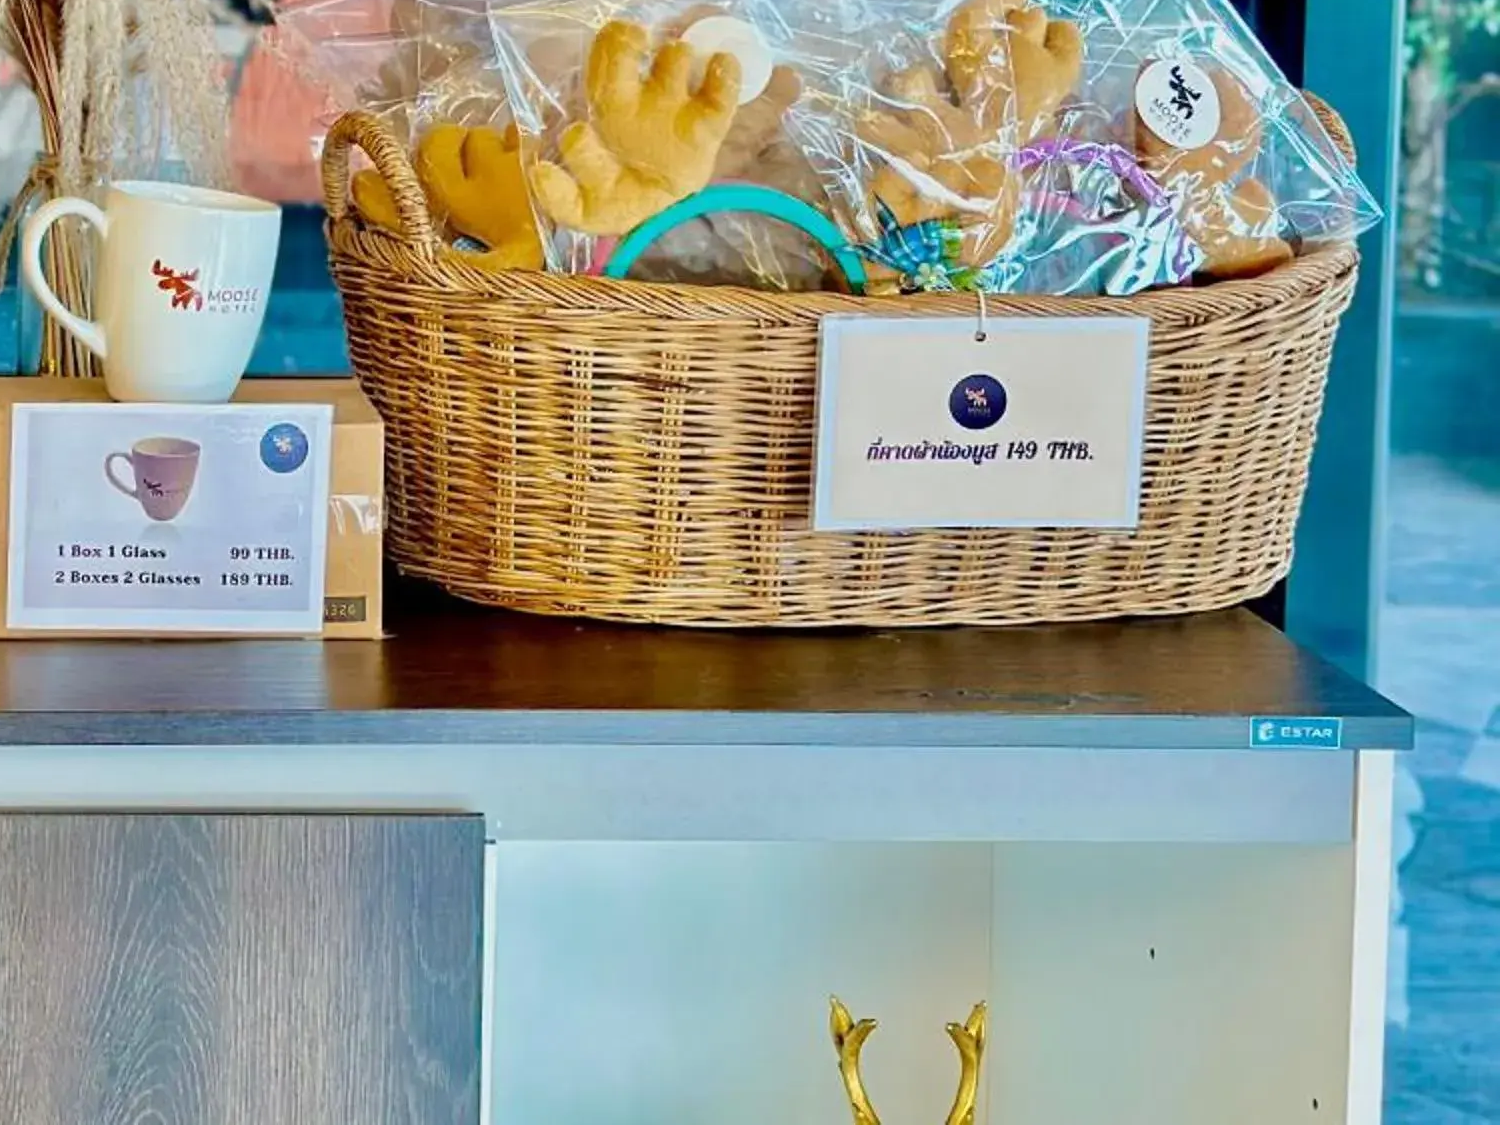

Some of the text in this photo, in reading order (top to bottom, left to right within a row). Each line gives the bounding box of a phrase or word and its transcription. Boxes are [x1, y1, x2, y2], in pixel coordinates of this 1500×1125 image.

[207, 287, 259, 303] MOOSE
[1006, 440, 1038, 460] 149
[1047, 440, 1094, 460] THB.
[57, 544, 295, 560] 1 Box 1 Glass 99 THB.
[55, 571, 294, 586] 2 Boxes 2 Glasses 189 THB.
[1280, 725, 1333, 738] ESTAR
